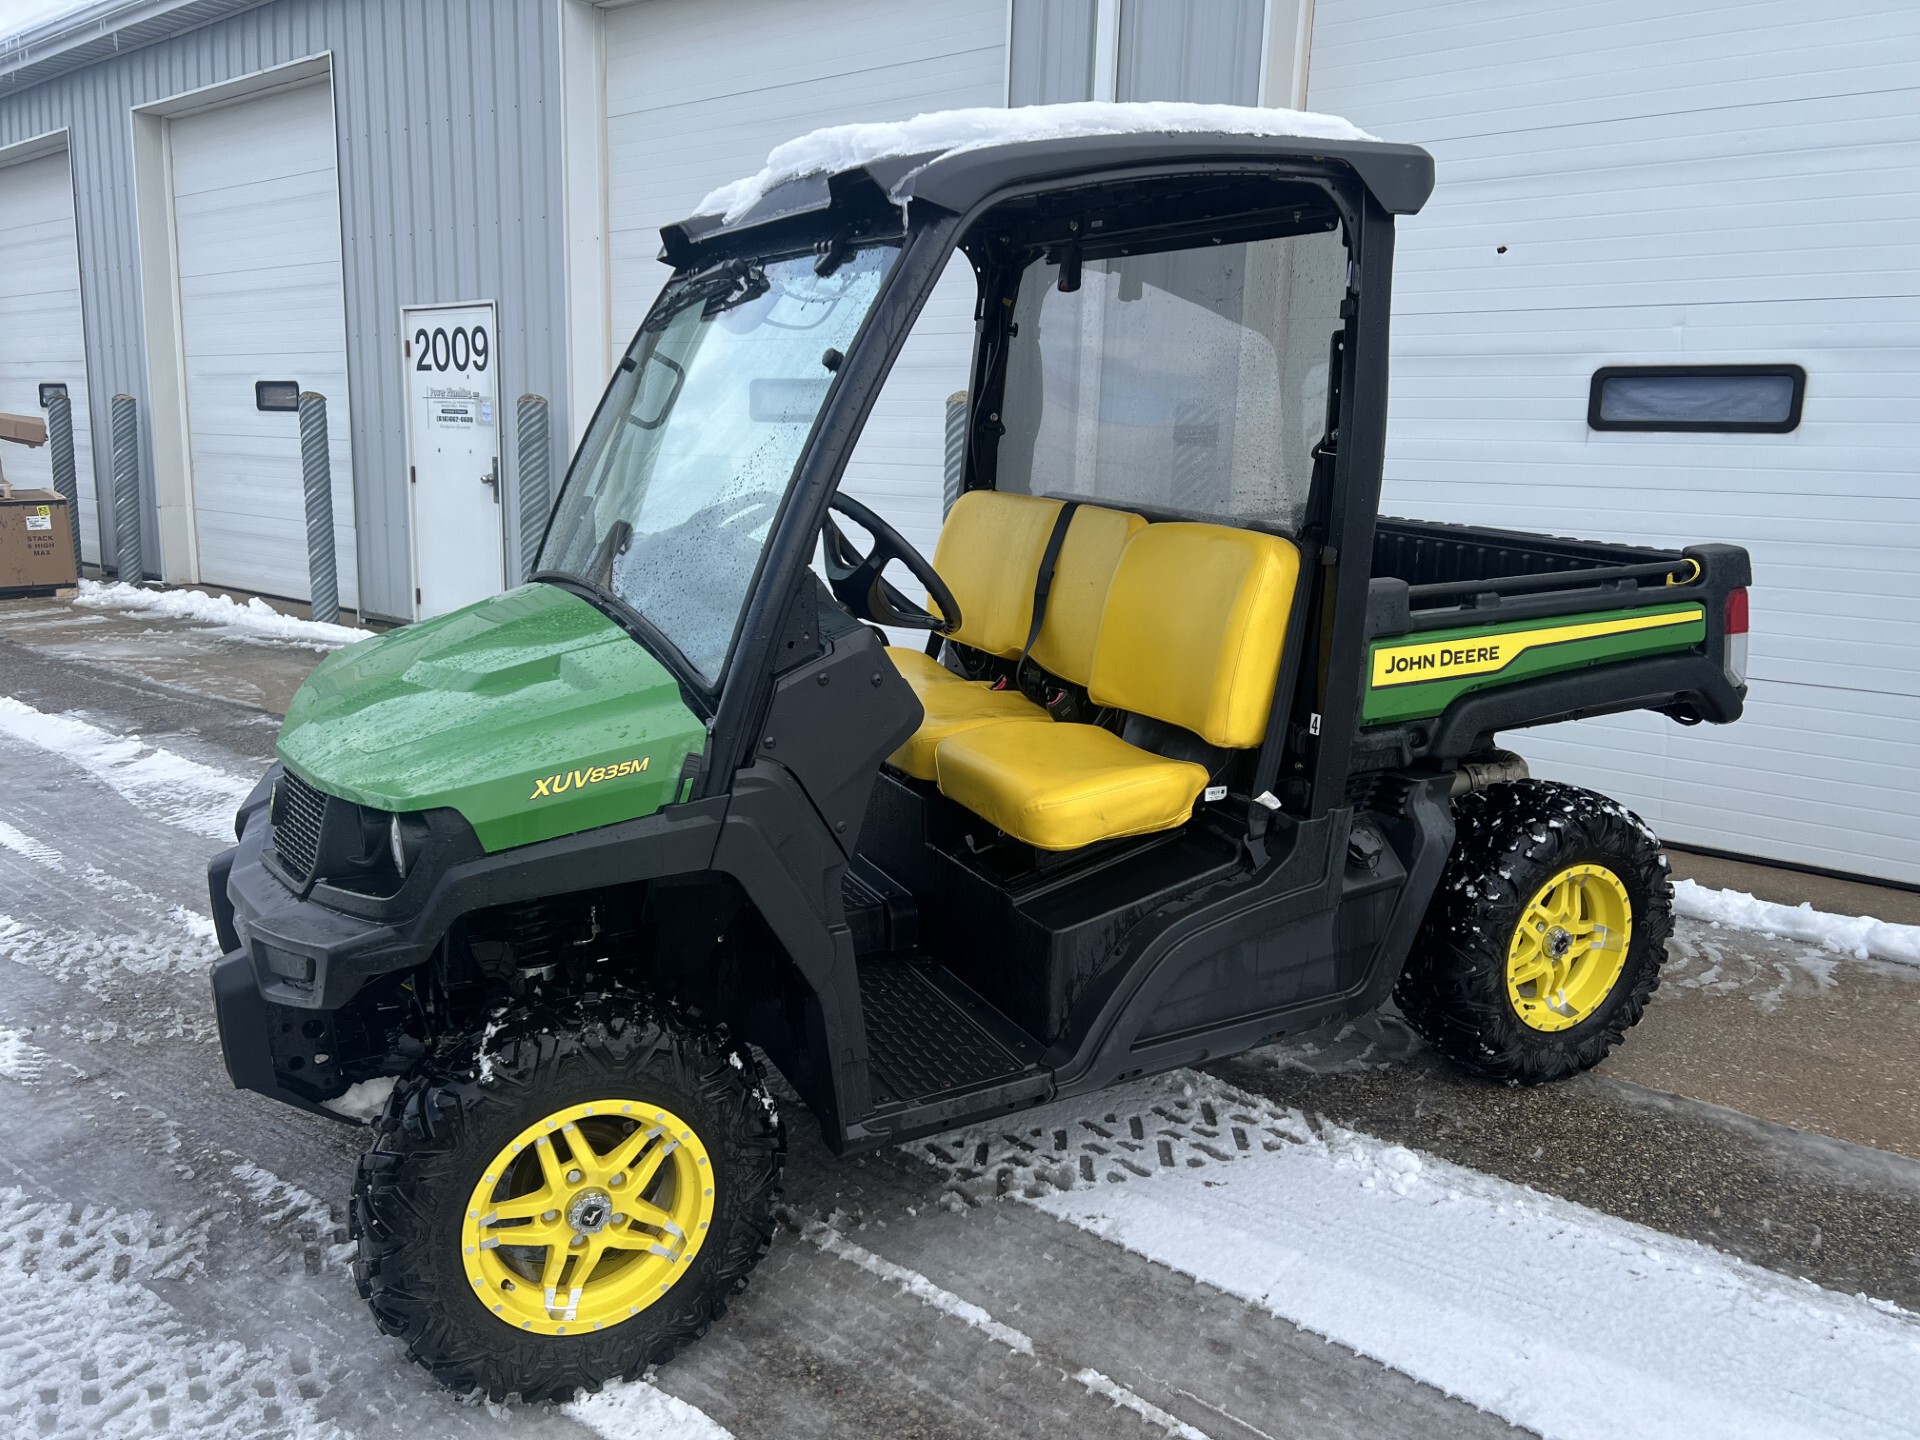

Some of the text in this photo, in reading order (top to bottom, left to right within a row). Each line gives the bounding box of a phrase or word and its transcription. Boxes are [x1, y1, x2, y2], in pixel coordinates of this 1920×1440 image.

[415, 325, 488, 372] 2009
[1385, 646, 1500, 674] JOHN DEERE
[1311, 716, 1319, 734] 4
[529, 756, 651, 800] XUV835M
